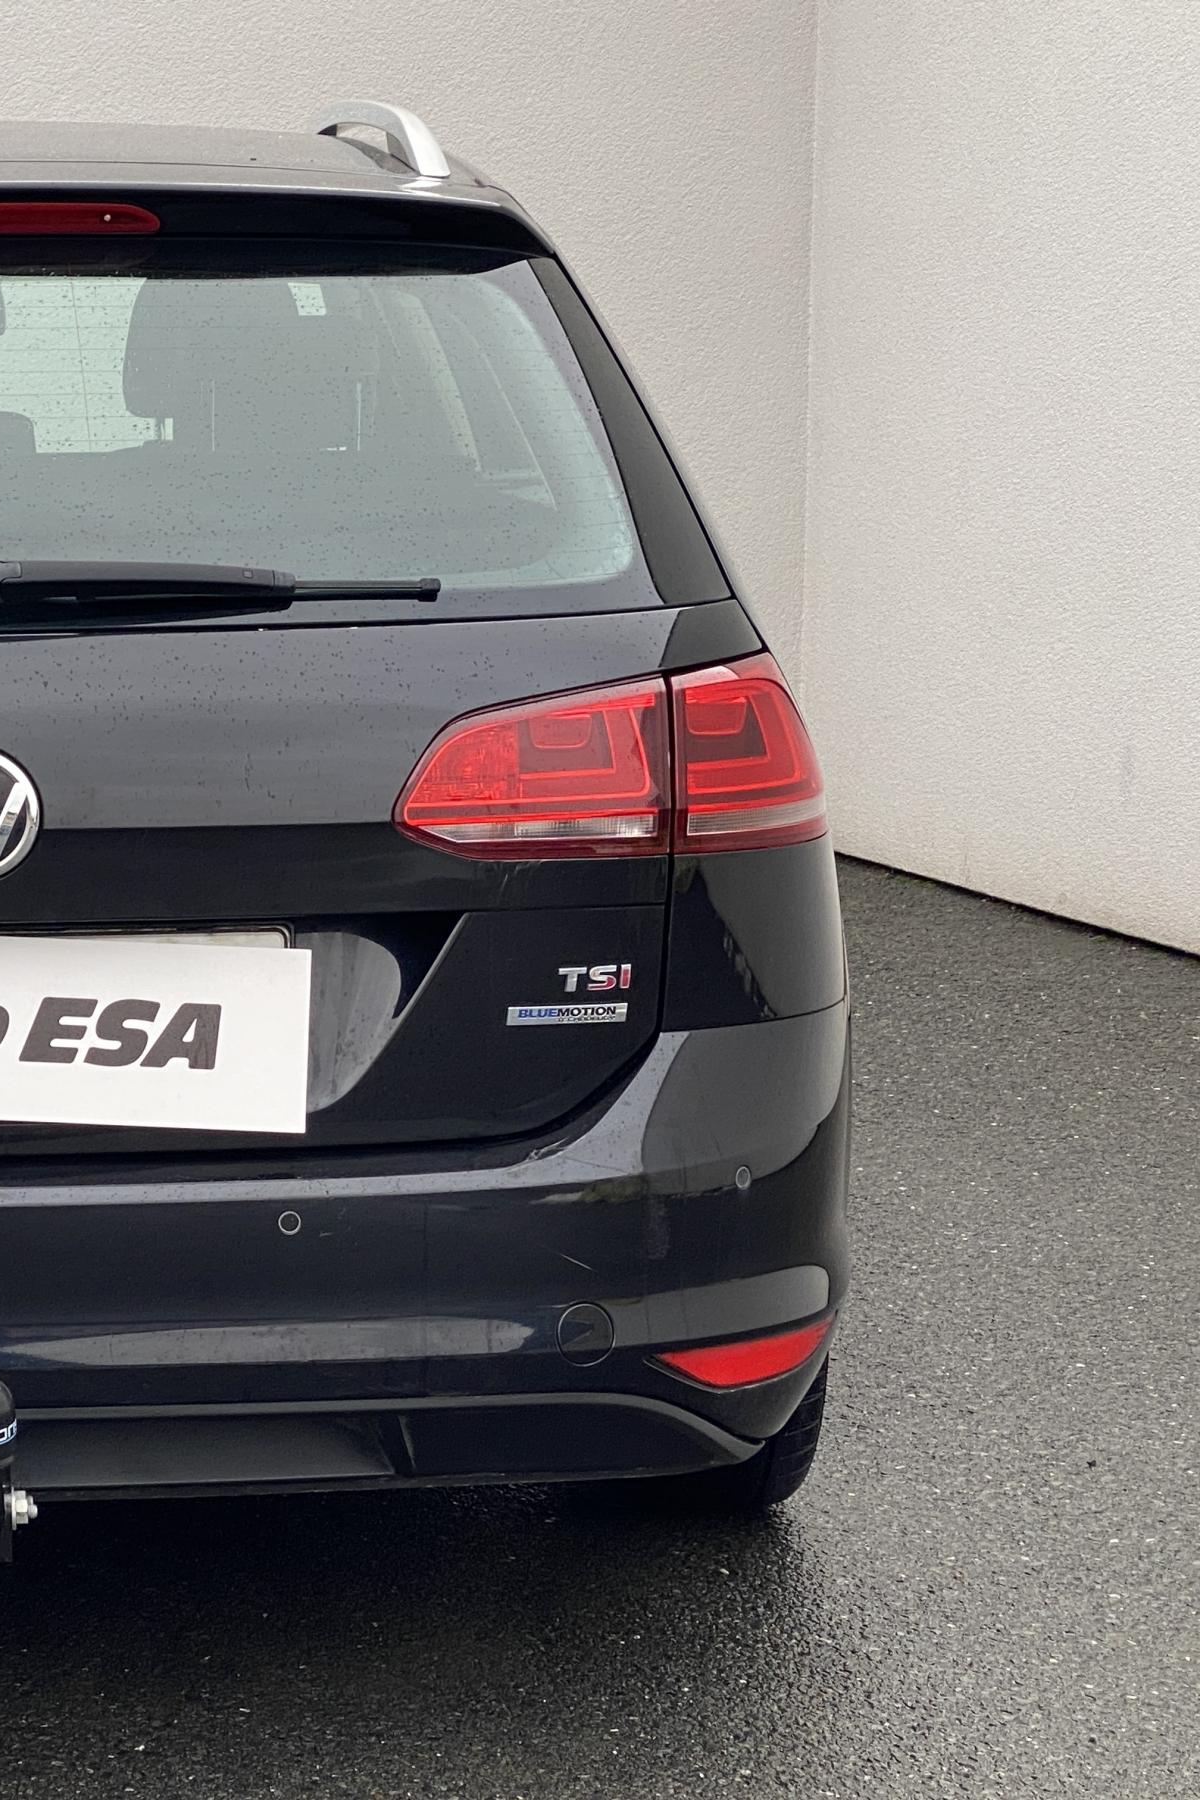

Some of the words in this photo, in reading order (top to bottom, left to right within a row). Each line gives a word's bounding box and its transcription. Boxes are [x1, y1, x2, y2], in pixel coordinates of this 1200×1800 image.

[557, 963, 632, 993] TSI
[517, 1006, 617, 1018] BLUEMOTION
[18, 996, 222, 1070] ESA
